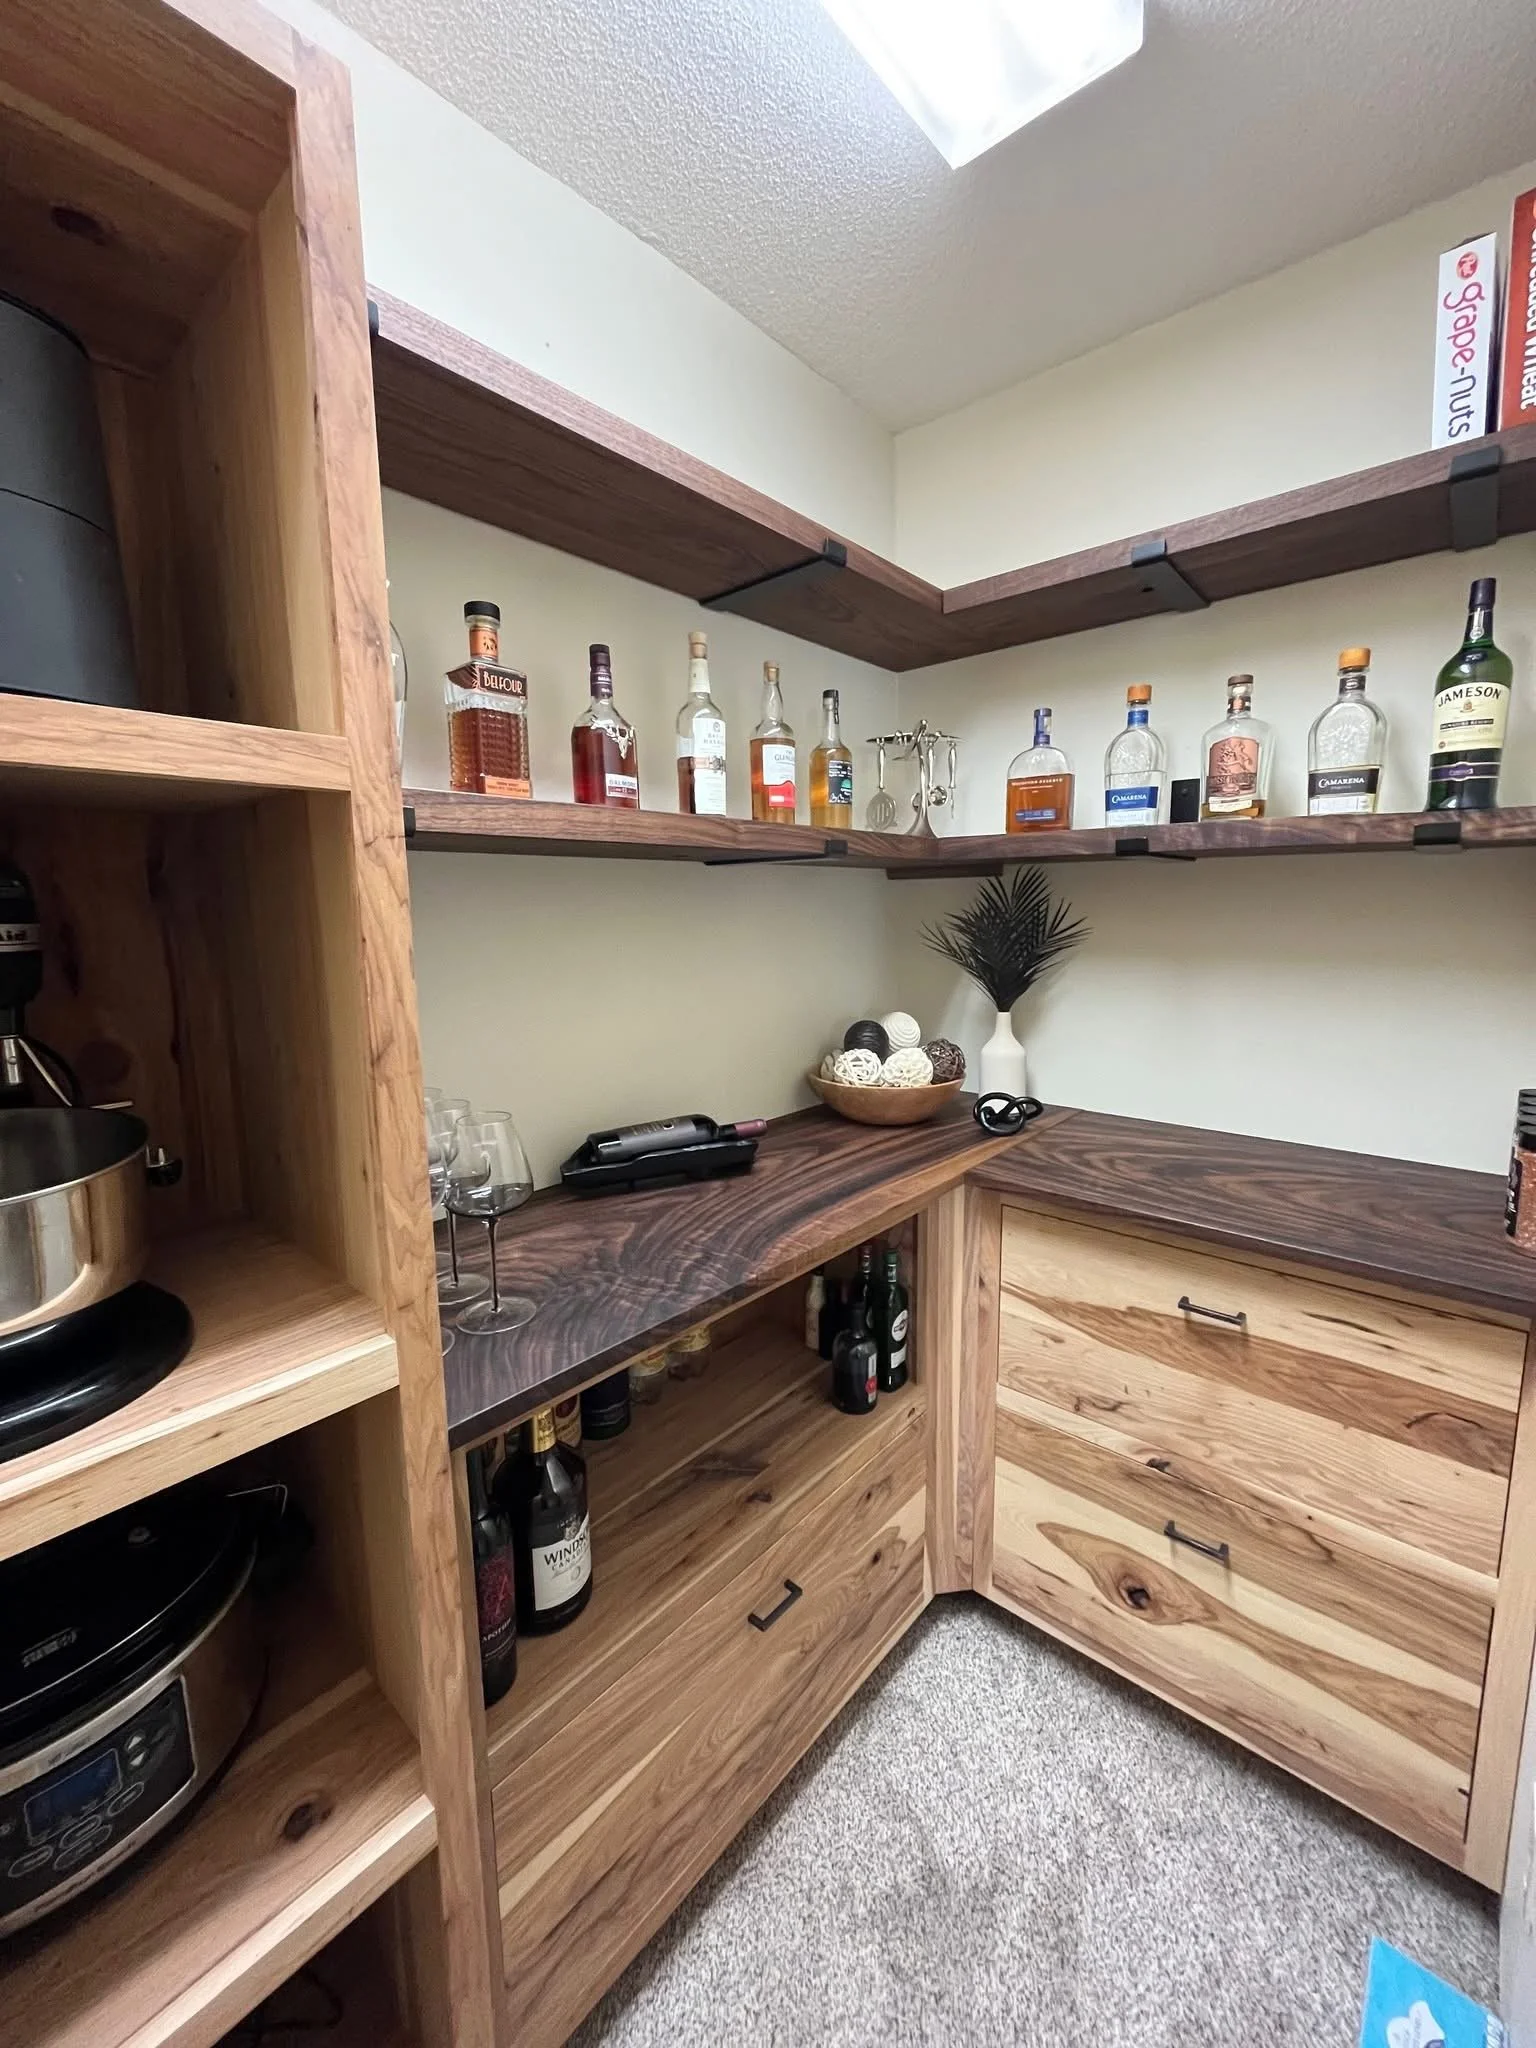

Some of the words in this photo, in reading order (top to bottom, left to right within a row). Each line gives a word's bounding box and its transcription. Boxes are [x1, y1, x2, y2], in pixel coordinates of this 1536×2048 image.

[1443, 281, 1486, 438] grape-nuts
[483, 670, 524, 694] BELFOUR
[1437, 686, 1502, 707] JAMESON
[1318, 776, 1365, 788] CAMARENA
[1111, 793, 1147, 804] CAMARENA
